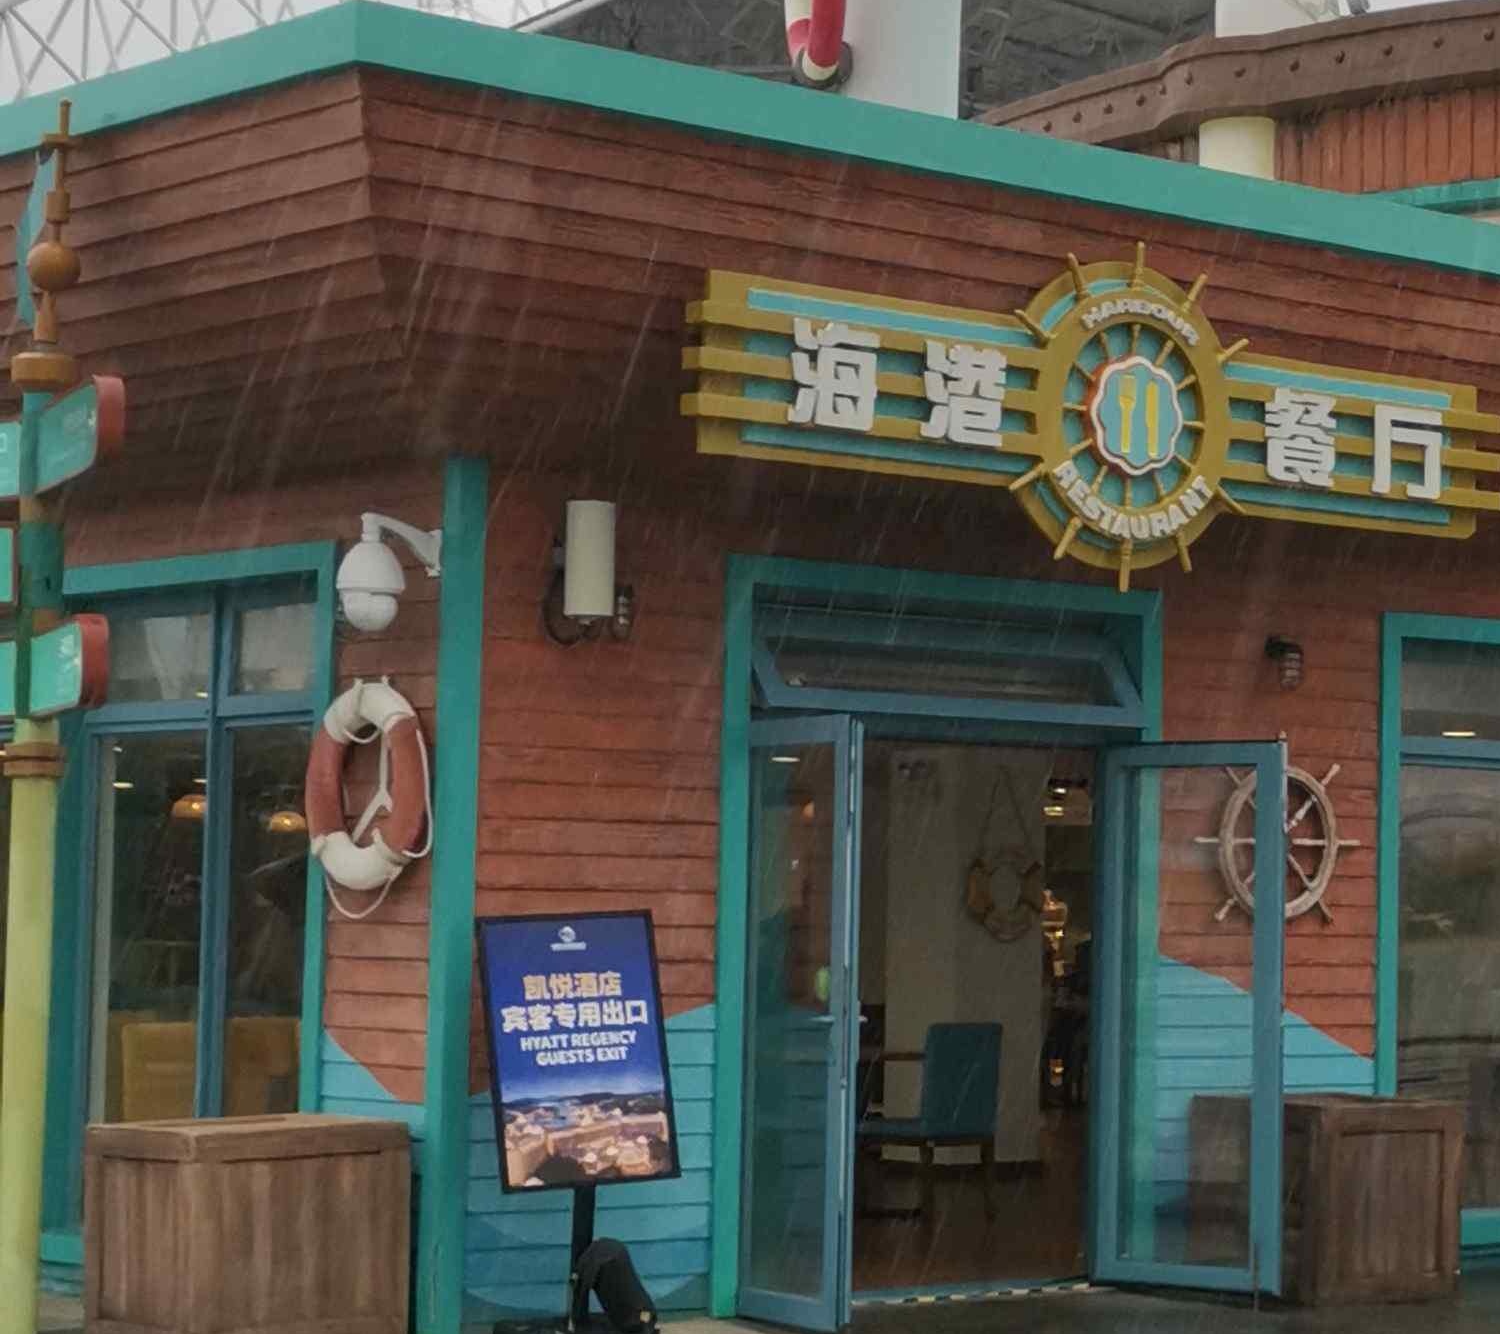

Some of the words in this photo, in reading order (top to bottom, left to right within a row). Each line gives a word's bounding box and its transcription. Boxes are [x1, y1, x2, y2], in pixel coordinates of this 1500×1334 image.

[787, 317, 1007, 448] 海港
[1264, 386, 1443, 500] 餐厅
[1052, 459, 1213, 540] RESTAURANT
[523, 971, 622, 1000] 凯悦酒店
[501, 999, 648, 1032] 宾客专用出口
[520, 1034, 568, 1051] HYATT
[571, 1030, 637, 1047] REGENCY
[536, 1049, 594, 1066] GUESTS
[597, 1046, 628, 1061] EXIT
